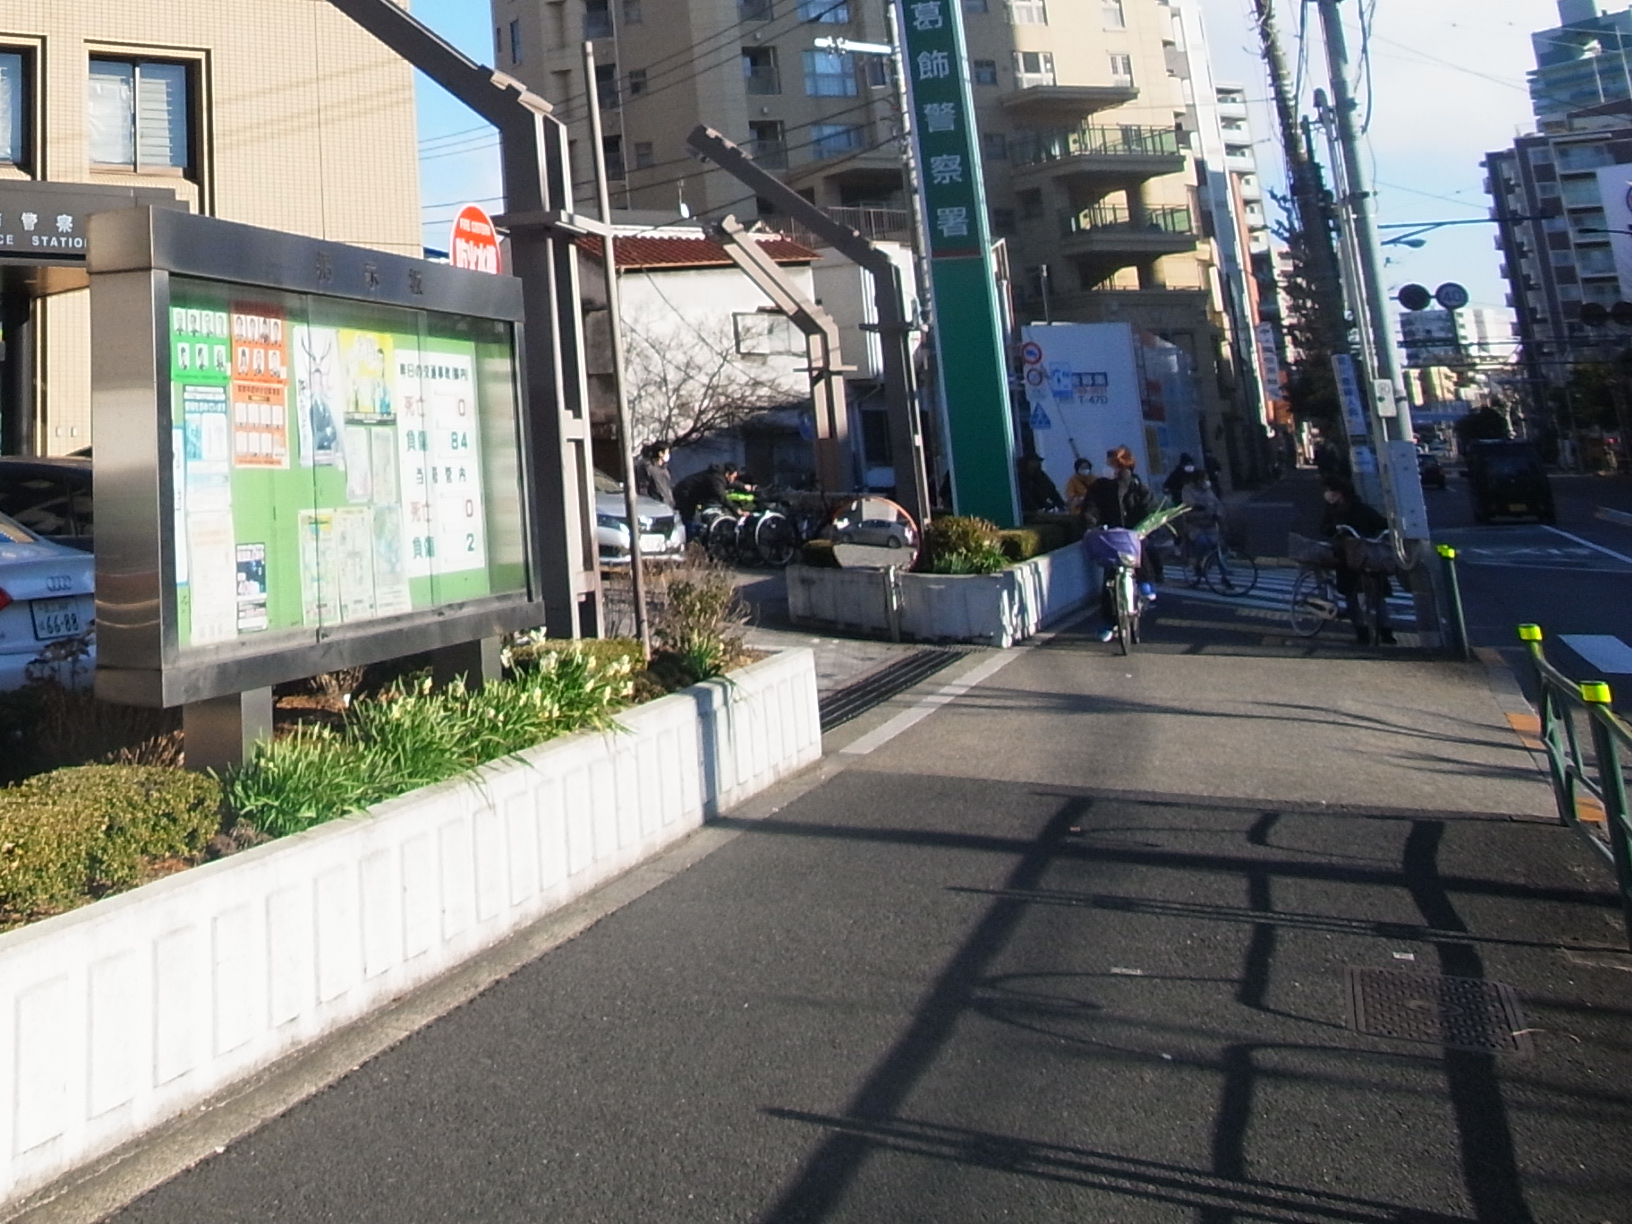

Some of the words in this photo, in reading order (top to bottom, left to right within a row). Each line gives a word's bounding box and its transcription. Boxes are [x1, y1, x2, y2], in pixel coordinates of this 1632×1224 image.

[911, 0, 969, 237] 葛飾警察署
[32, 236, 86, 249] STATIO
[404, 395, 425, 418] 死亡
[458, 398, 466, 417] 0
[451, 431, 468, 450] 84
[410, 501, 432, 523] 死亡
[465, 499, 474, 518] 0
[466, 533, 475, 552] 2
